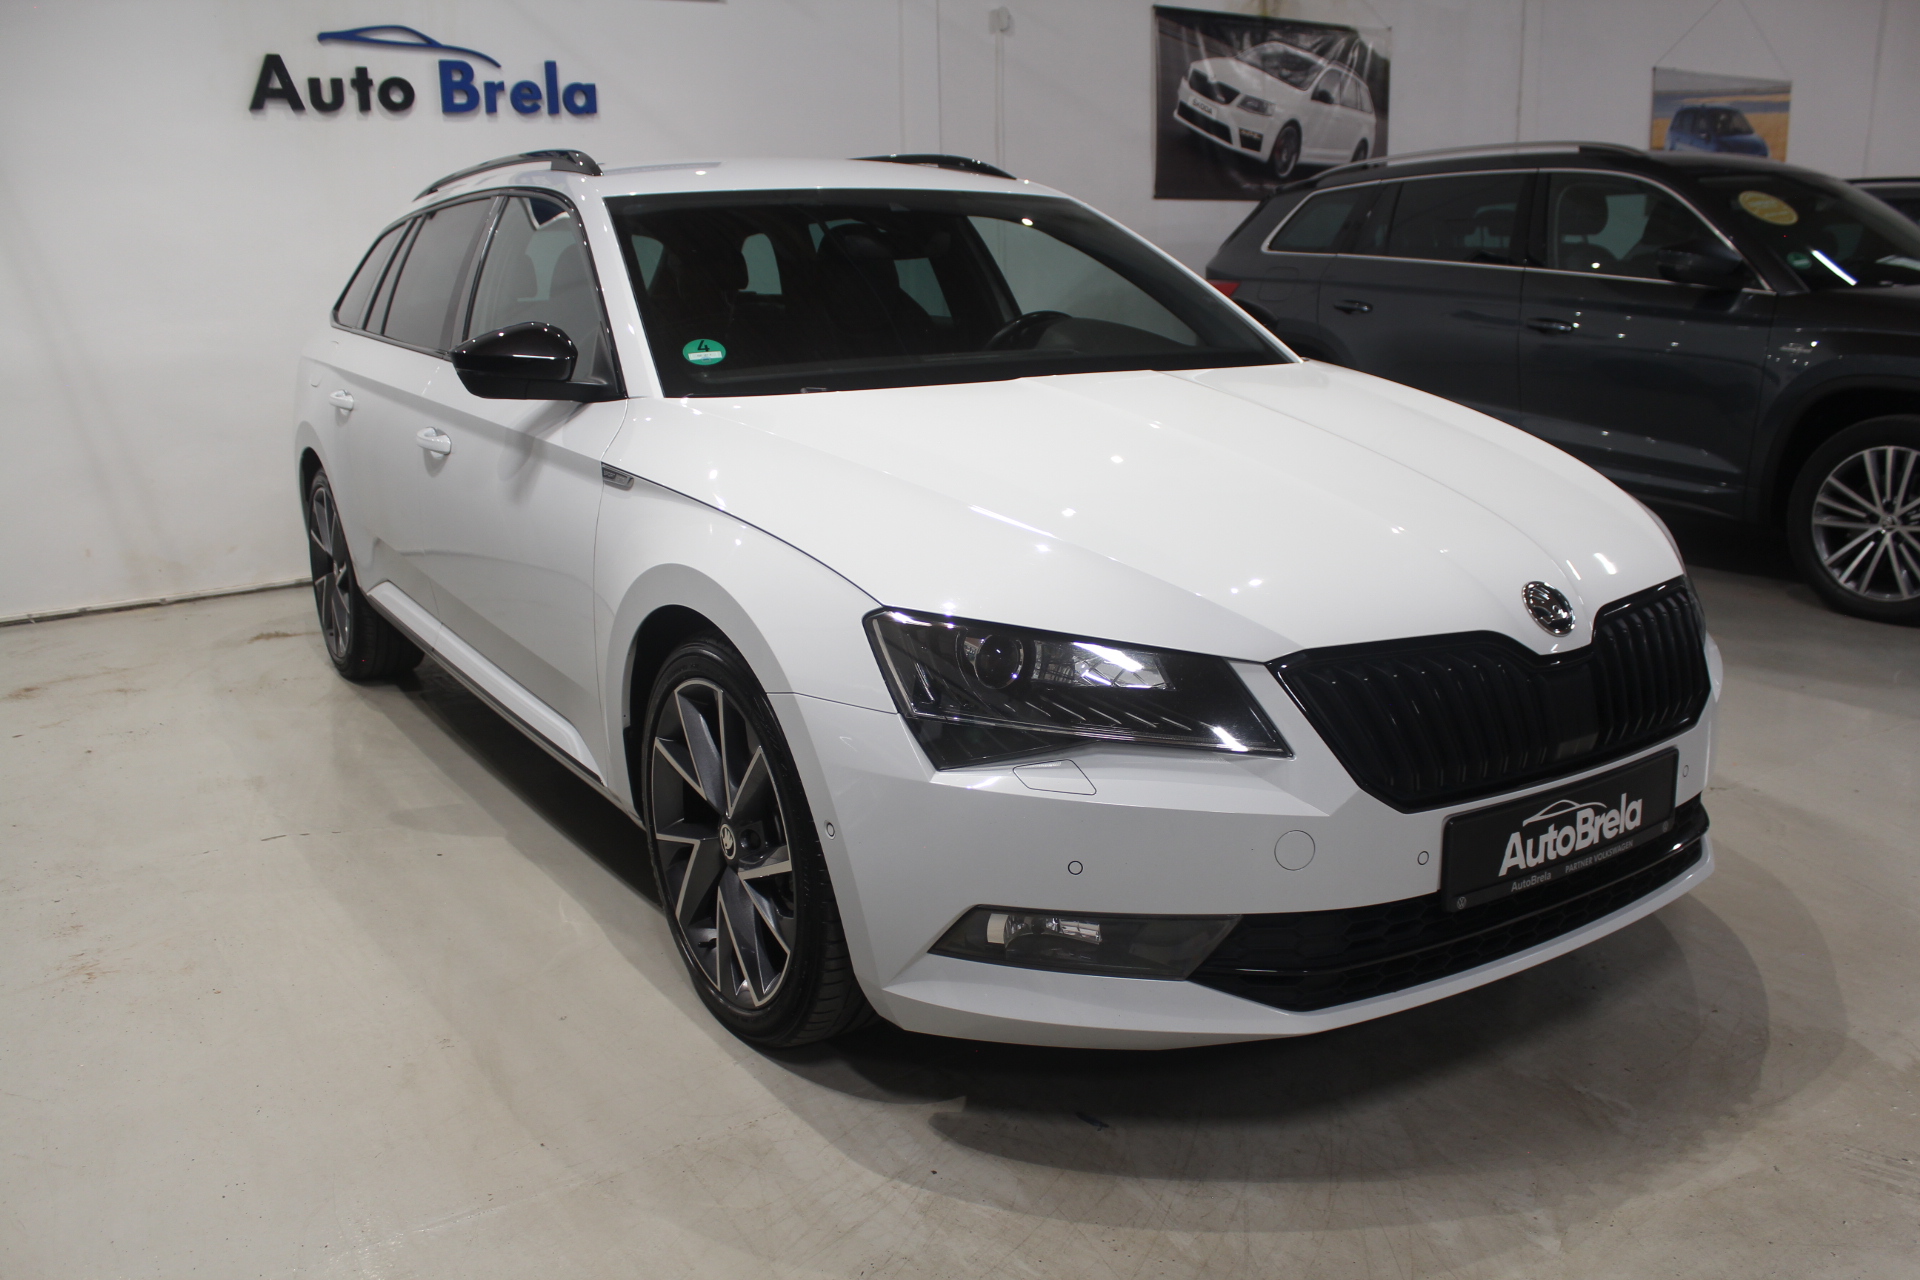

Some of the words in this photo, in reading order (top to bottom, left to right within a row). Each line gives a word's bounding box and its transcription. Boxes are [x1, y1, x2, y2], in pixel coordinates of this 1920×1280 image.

[249, 53, 416, 112] Auto
[438, 59, 598, 115] Brela
[697, 340, 710, 352] 4
[1498, 792, 1643, 877] AutoBrela
[1565, 856, 1593, 873] PARTNER
[1594, 839, 1634, 862] VOLKSWAGEN
[1511, 872, 1552, 893] AutoBrela
